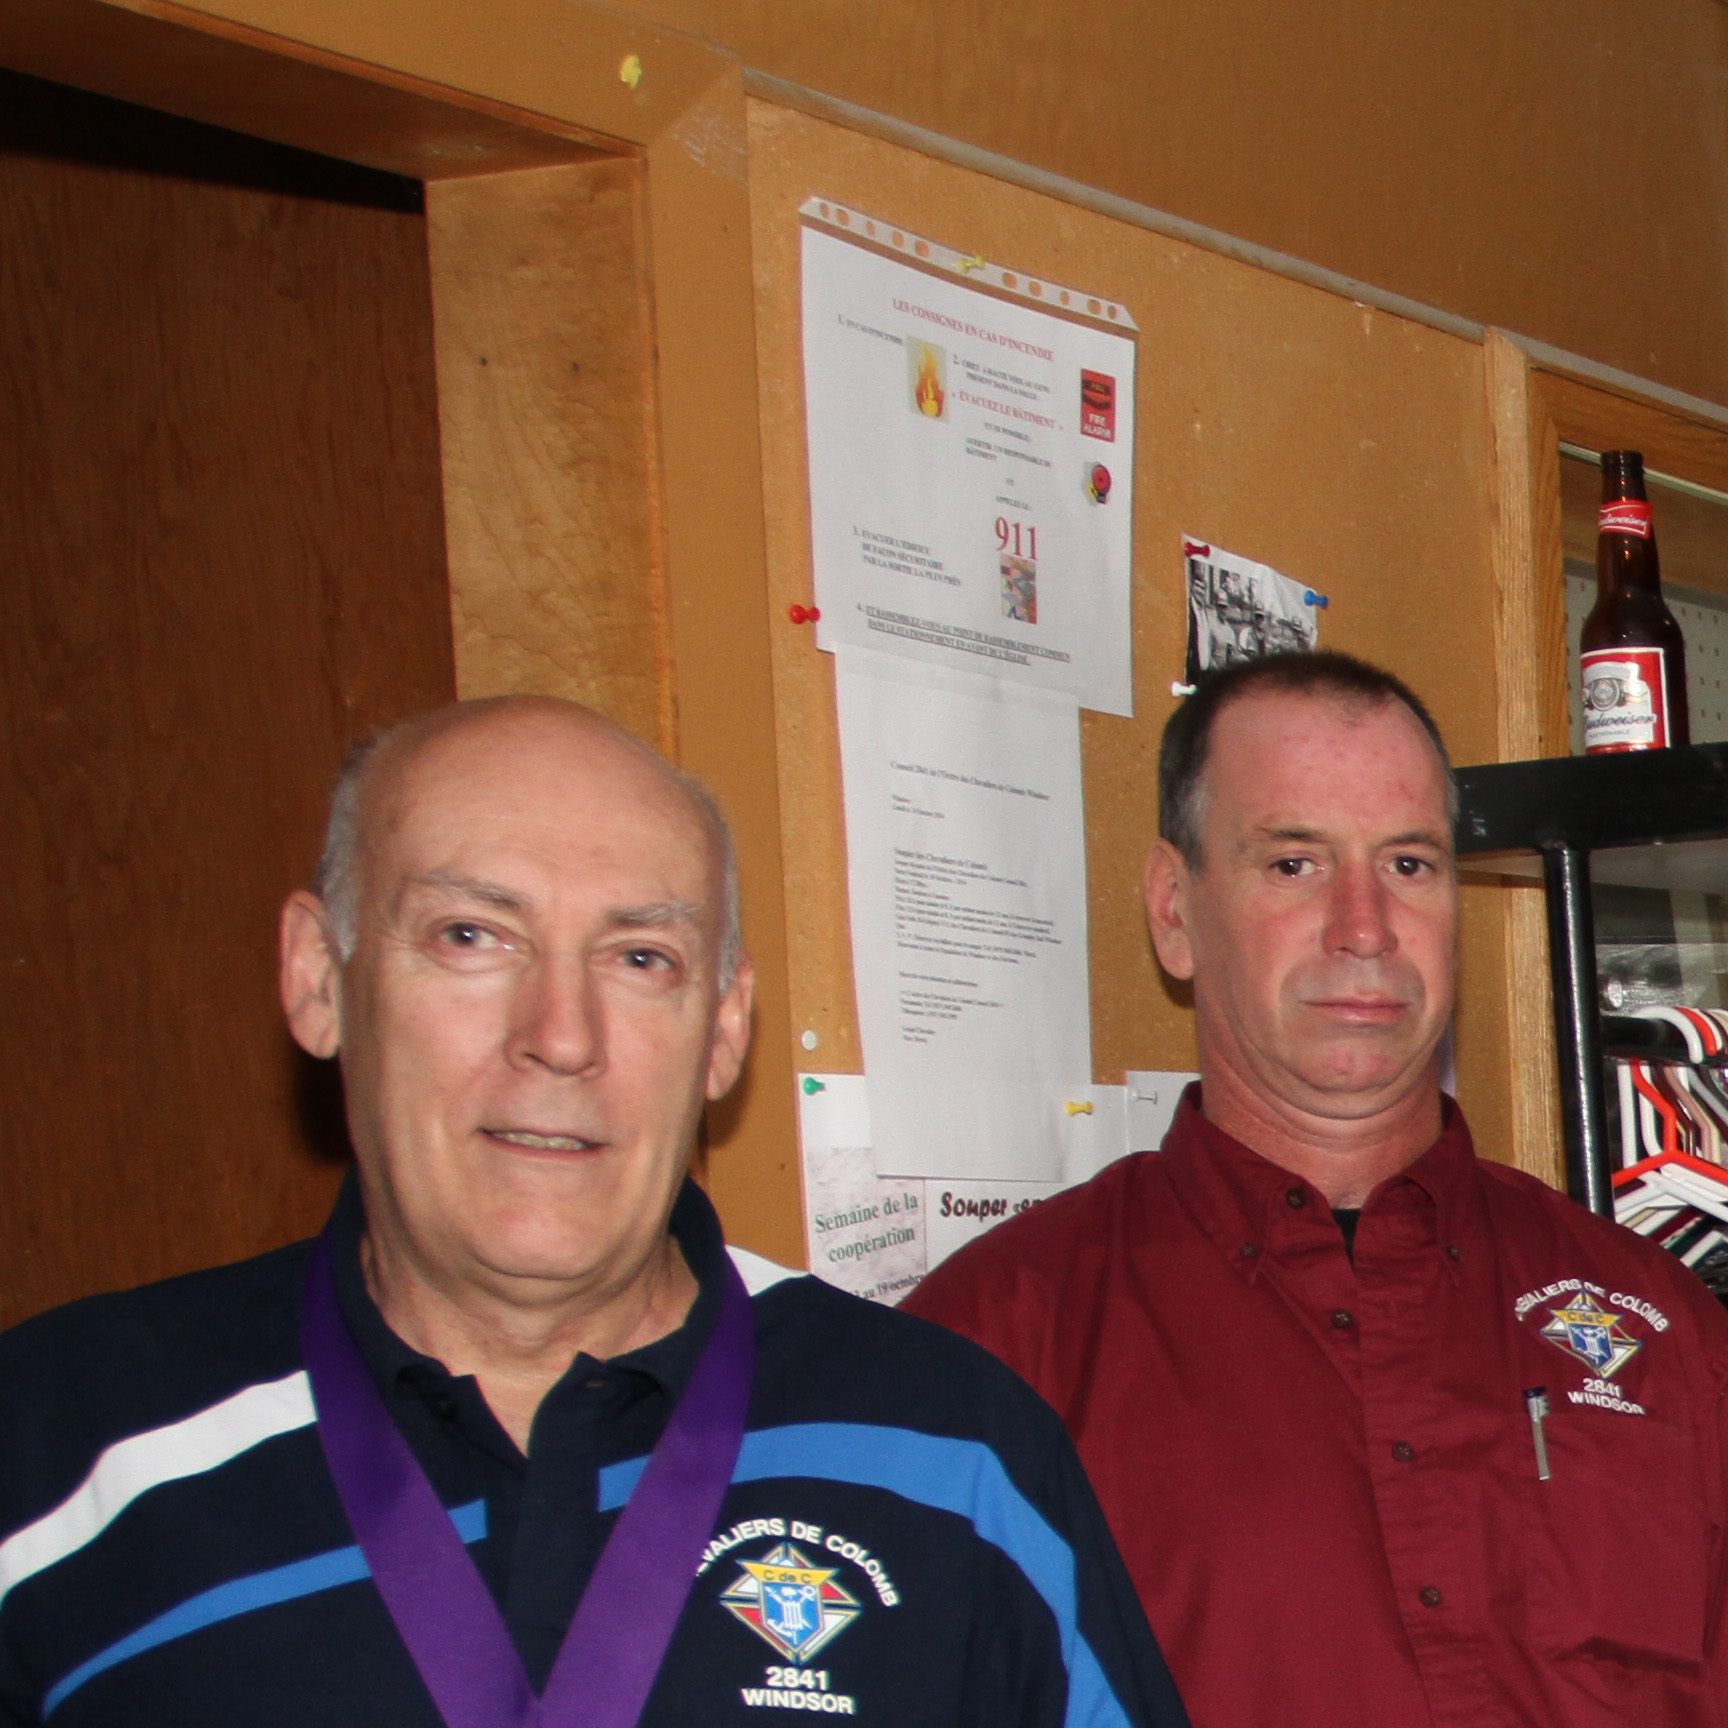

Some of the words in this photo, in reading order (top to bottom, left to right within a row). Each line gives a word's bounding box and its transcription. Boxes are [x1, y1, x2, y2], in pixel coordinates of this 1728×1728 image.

[892, 298, 909, 313] LES
[911, 304, 964, 331] CONSIGNES
[966, 320, 978, 336] EN
[980, 323, 997, 341] CAS
[995, 515, 1038, 561] 911
[814, 1204, 880, 1234] Semaine
[882, 1198, 901, 1215] de
[903, 1192, 918, 1211] la
[940, 1191, 1007, 1223] Souper
[828, 1225, 916, 1263] coopération
[1568, 1311, 1576, 1321] C
[1584, 1281, 1607, 1298] DE
[1609, 1292, 1670, 1332] COLOMB
[1567, 1391, 1645, 1416] WINDSOR
[1582, 1378, 1622, 1398] 2841
[763, 1569, 775, 1581] C
[778, 1571, 798, 1583] de
[800, 1573, 812, 1584] C
[790, 1520, 824, 1545] DE
[825, 1534, 901, 1607] COLOMB
[764, 1665, 830, 1691] 2841
[740, 1687, 857, 1716] WINDSOR
